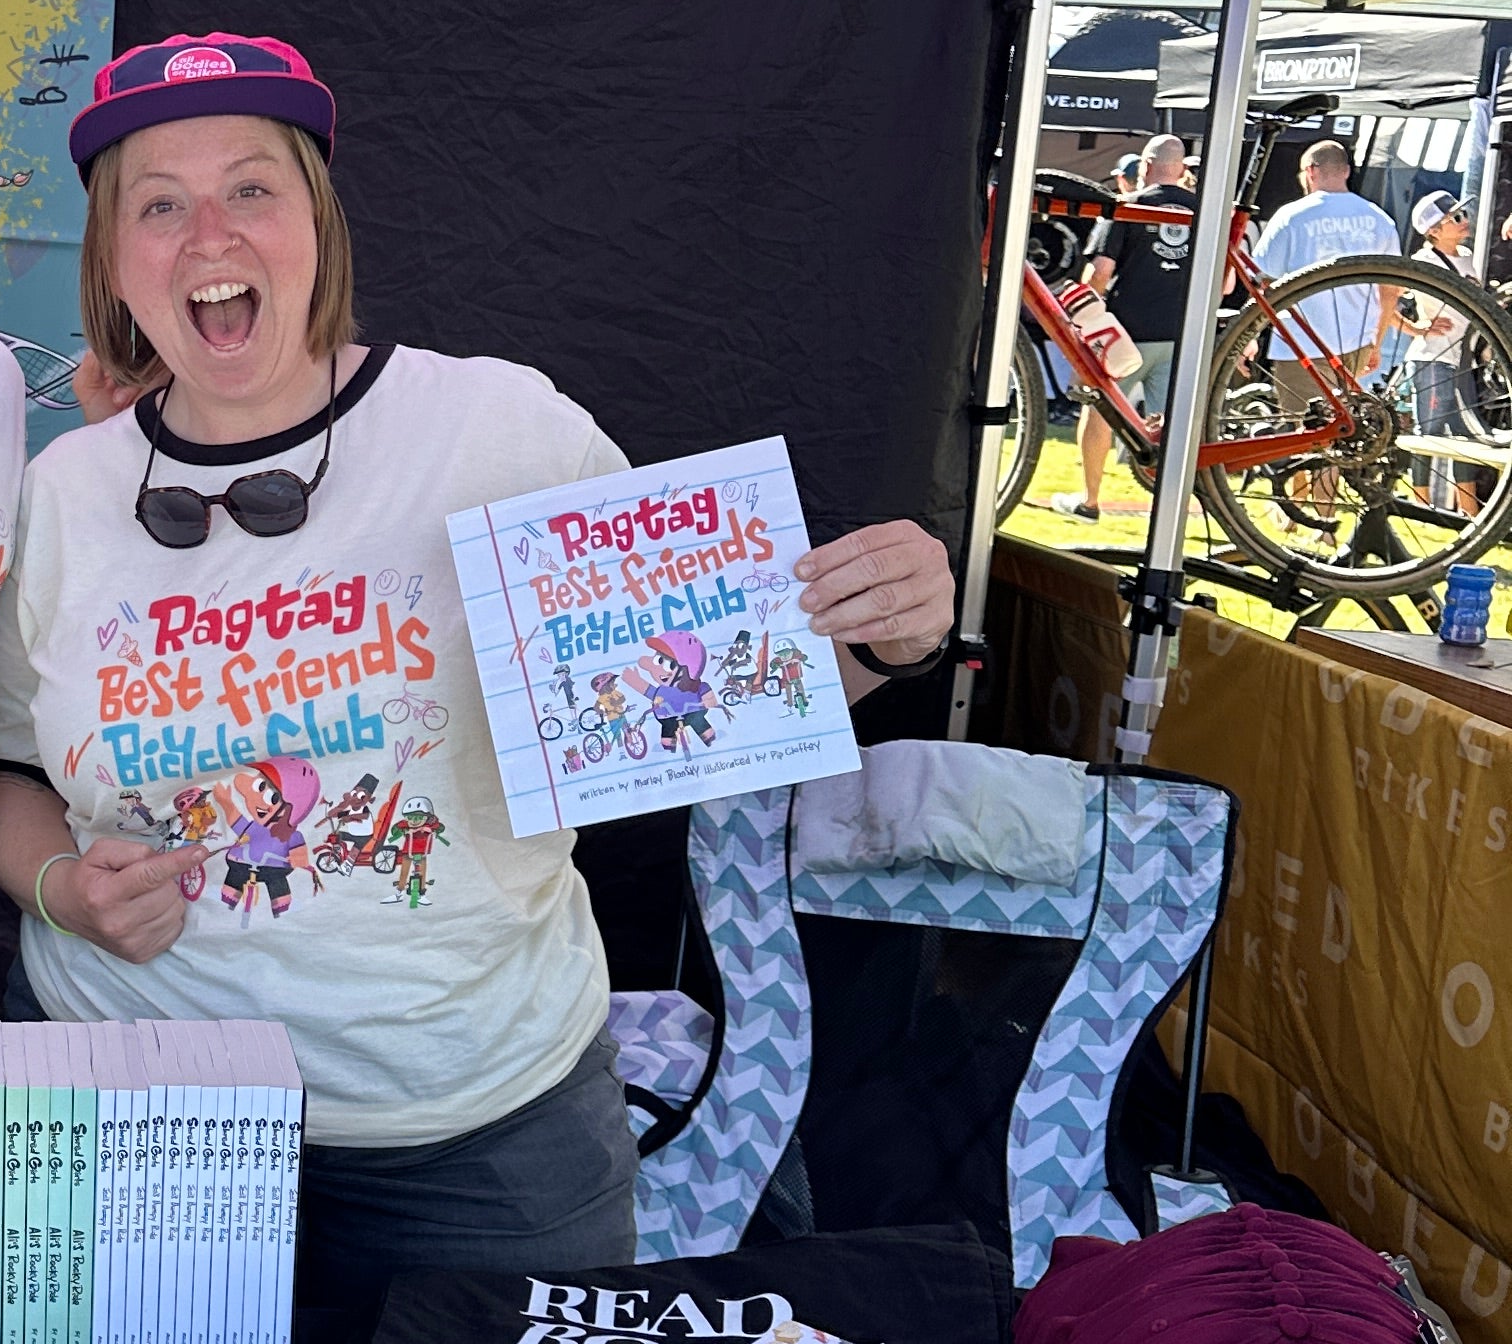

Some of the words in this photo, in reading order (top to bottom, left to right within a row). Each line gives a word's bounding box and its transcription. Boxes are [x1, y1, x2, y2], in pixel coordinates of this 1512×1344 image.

[172, 60, 227, 70] bodies
[530, 566, 613, 618] Best
[621, 508, 774, 606] friends
[547, 487, 718, 562] Ragtag
[148, 575, 366, 656] Ragtag
[545, 606, 654, 663] Bicycle
[661, 577, 746, 632] Club
[97, 657, 204, 722] Best
[217, 602, 435, 727] friends
[102, 722, 257, 787] Bicycle
[265, 692, 384, 758] Club
[619, 782, 629, 792] by
[634, 774, 662, 789] Marley
[755, 751, 766, 763] by
[520, 1276, 794, 1338] READ
